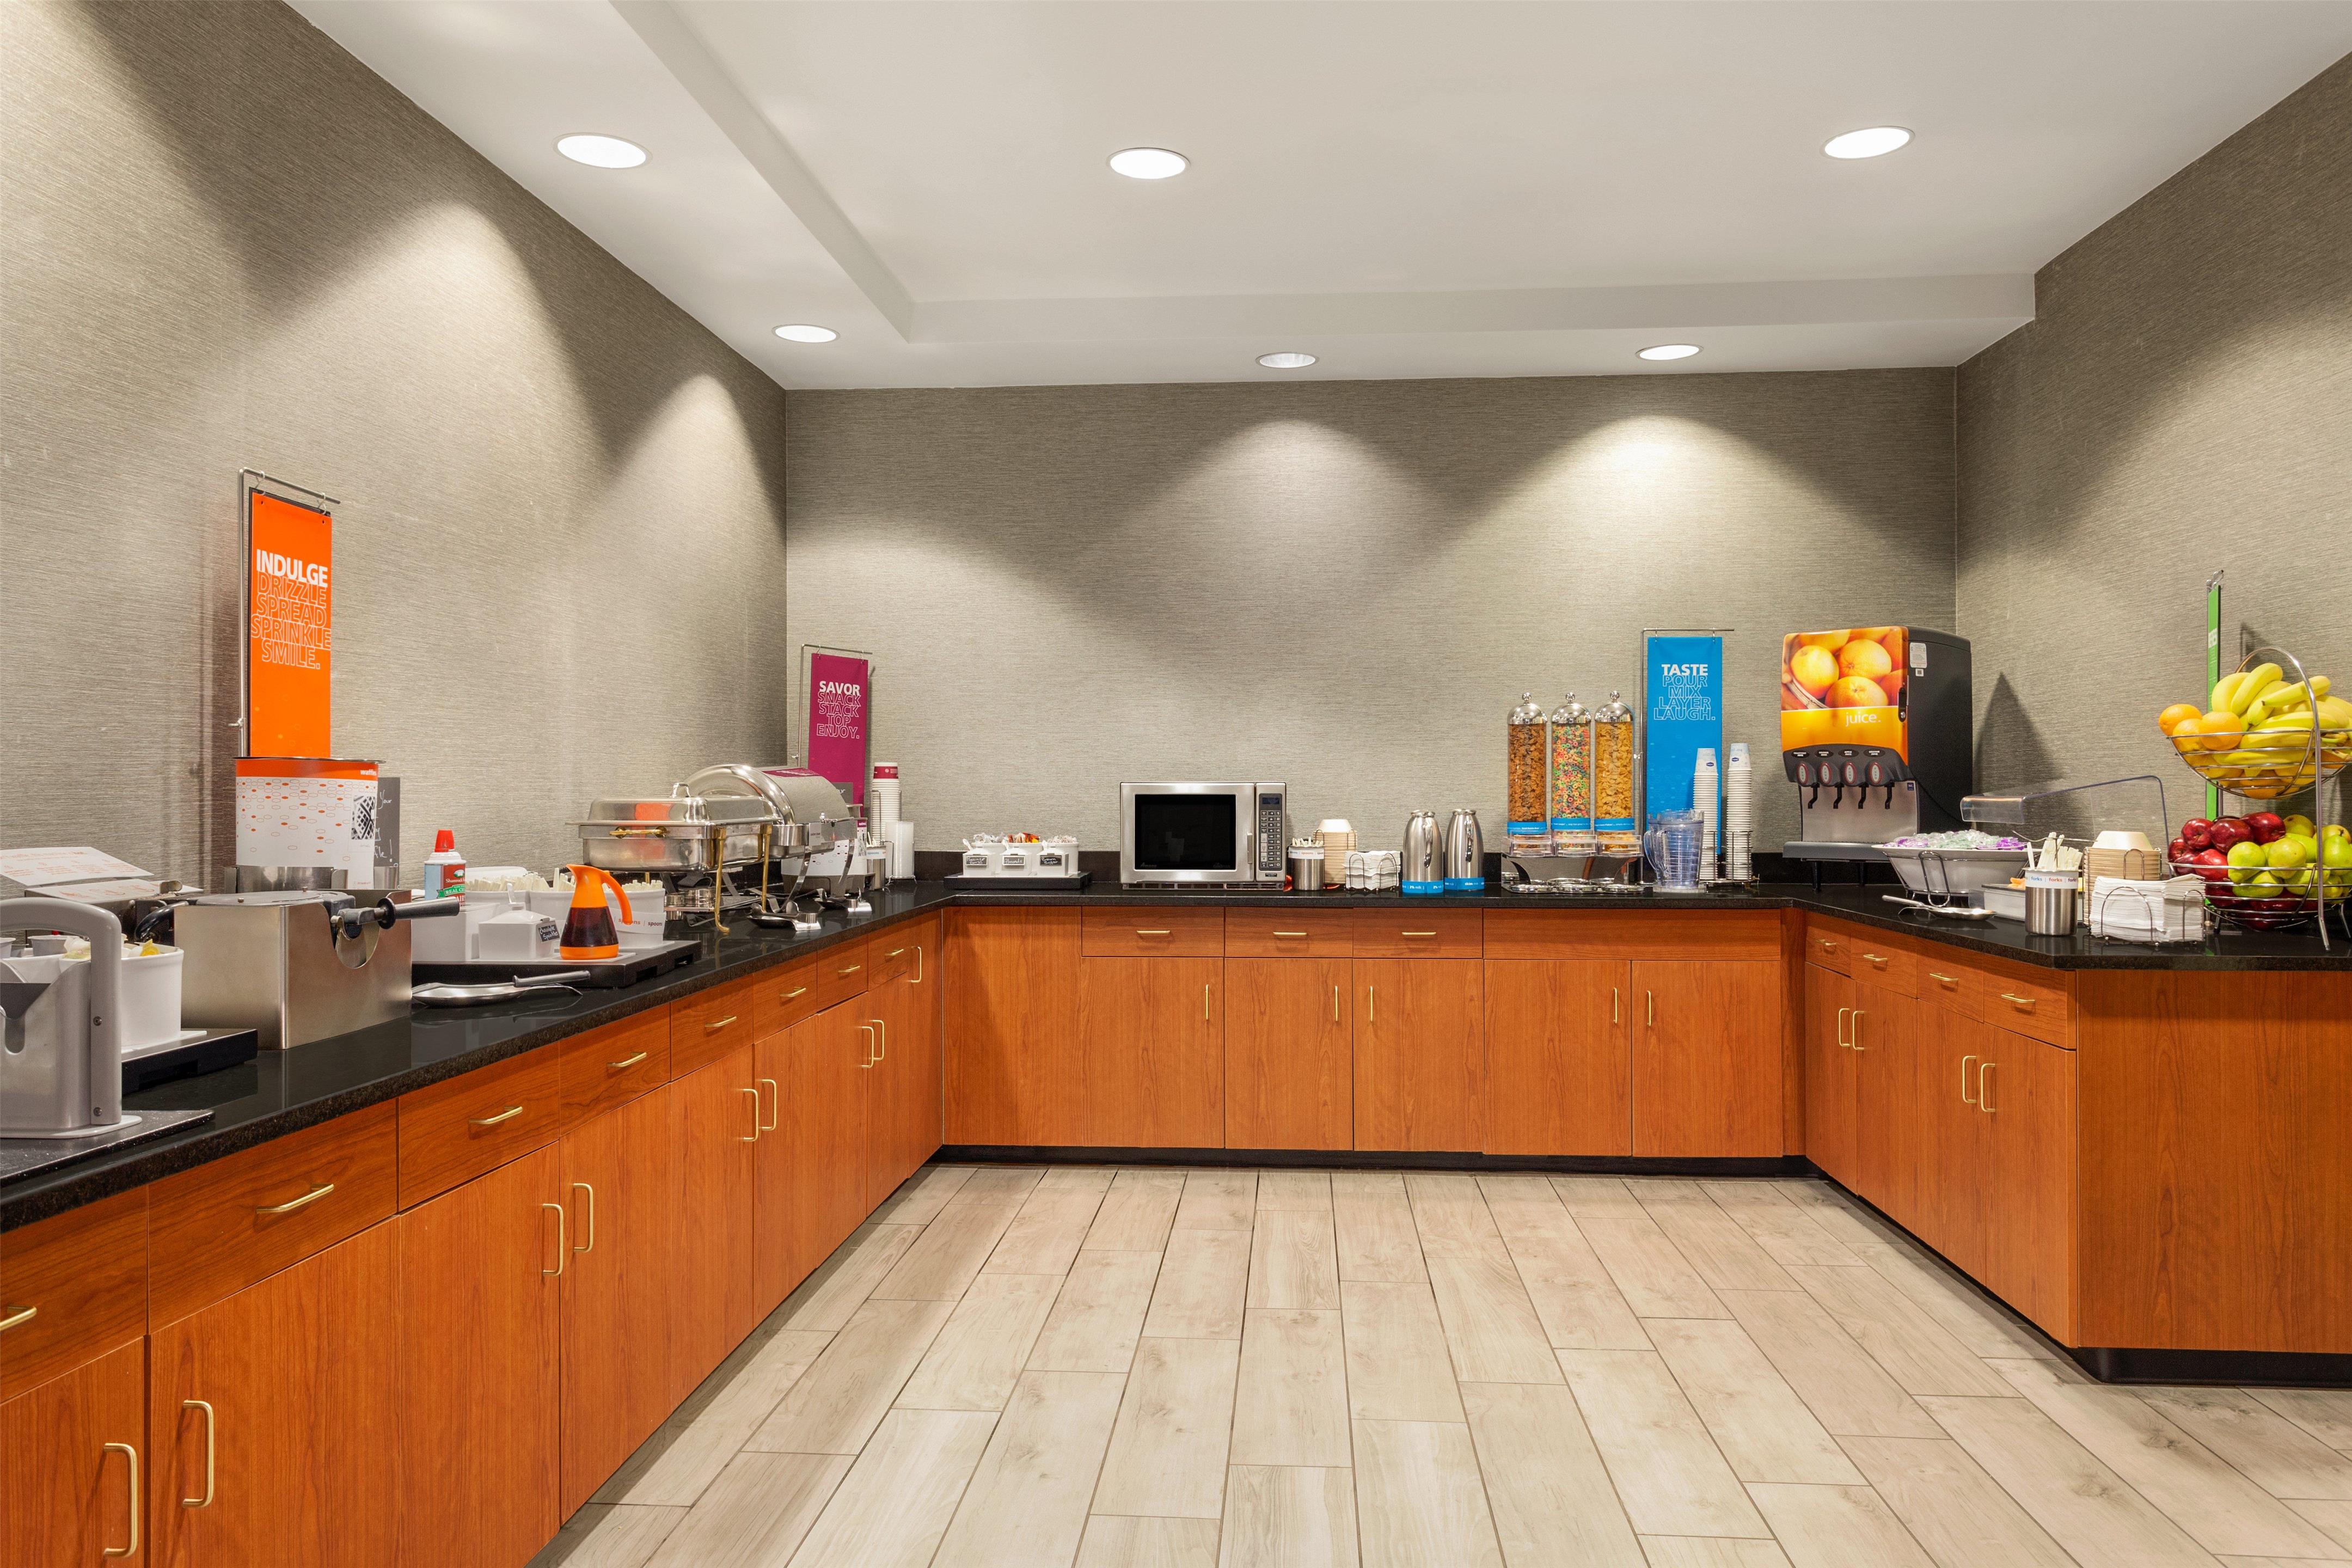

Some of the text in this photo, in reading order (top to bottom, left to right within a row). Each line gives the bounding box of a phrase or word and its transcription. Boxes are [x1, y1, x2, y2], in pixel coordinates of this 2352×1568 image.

[256, 549, 328, 587] INDULGE
[257, 572, 327, 608] DRIZZLE
[256, 595, 327, 628] SPREAD
[251, 614, 332, 651] SPRINKLE
[262, 638, 321, 670] SMILE.
[1661, 664, 1708, 676] TASTE
[819, 681, 860, 696] SAVOR
[1662, 675, 1707, 687] POUR
[817, 691, 862, 707] SNACK
[1668, 685, 1702, 698] MIX
[818, 702, 859, 717] STACK
[1658, 696, 1711, 709] LAYER
[826, 714, 851, 727] TOP
[1653, 707, 1716, 720] LAUGH.
[1845, 711, 1882, 727] juice.
[817, 724, 860, 739] ENJOY.
